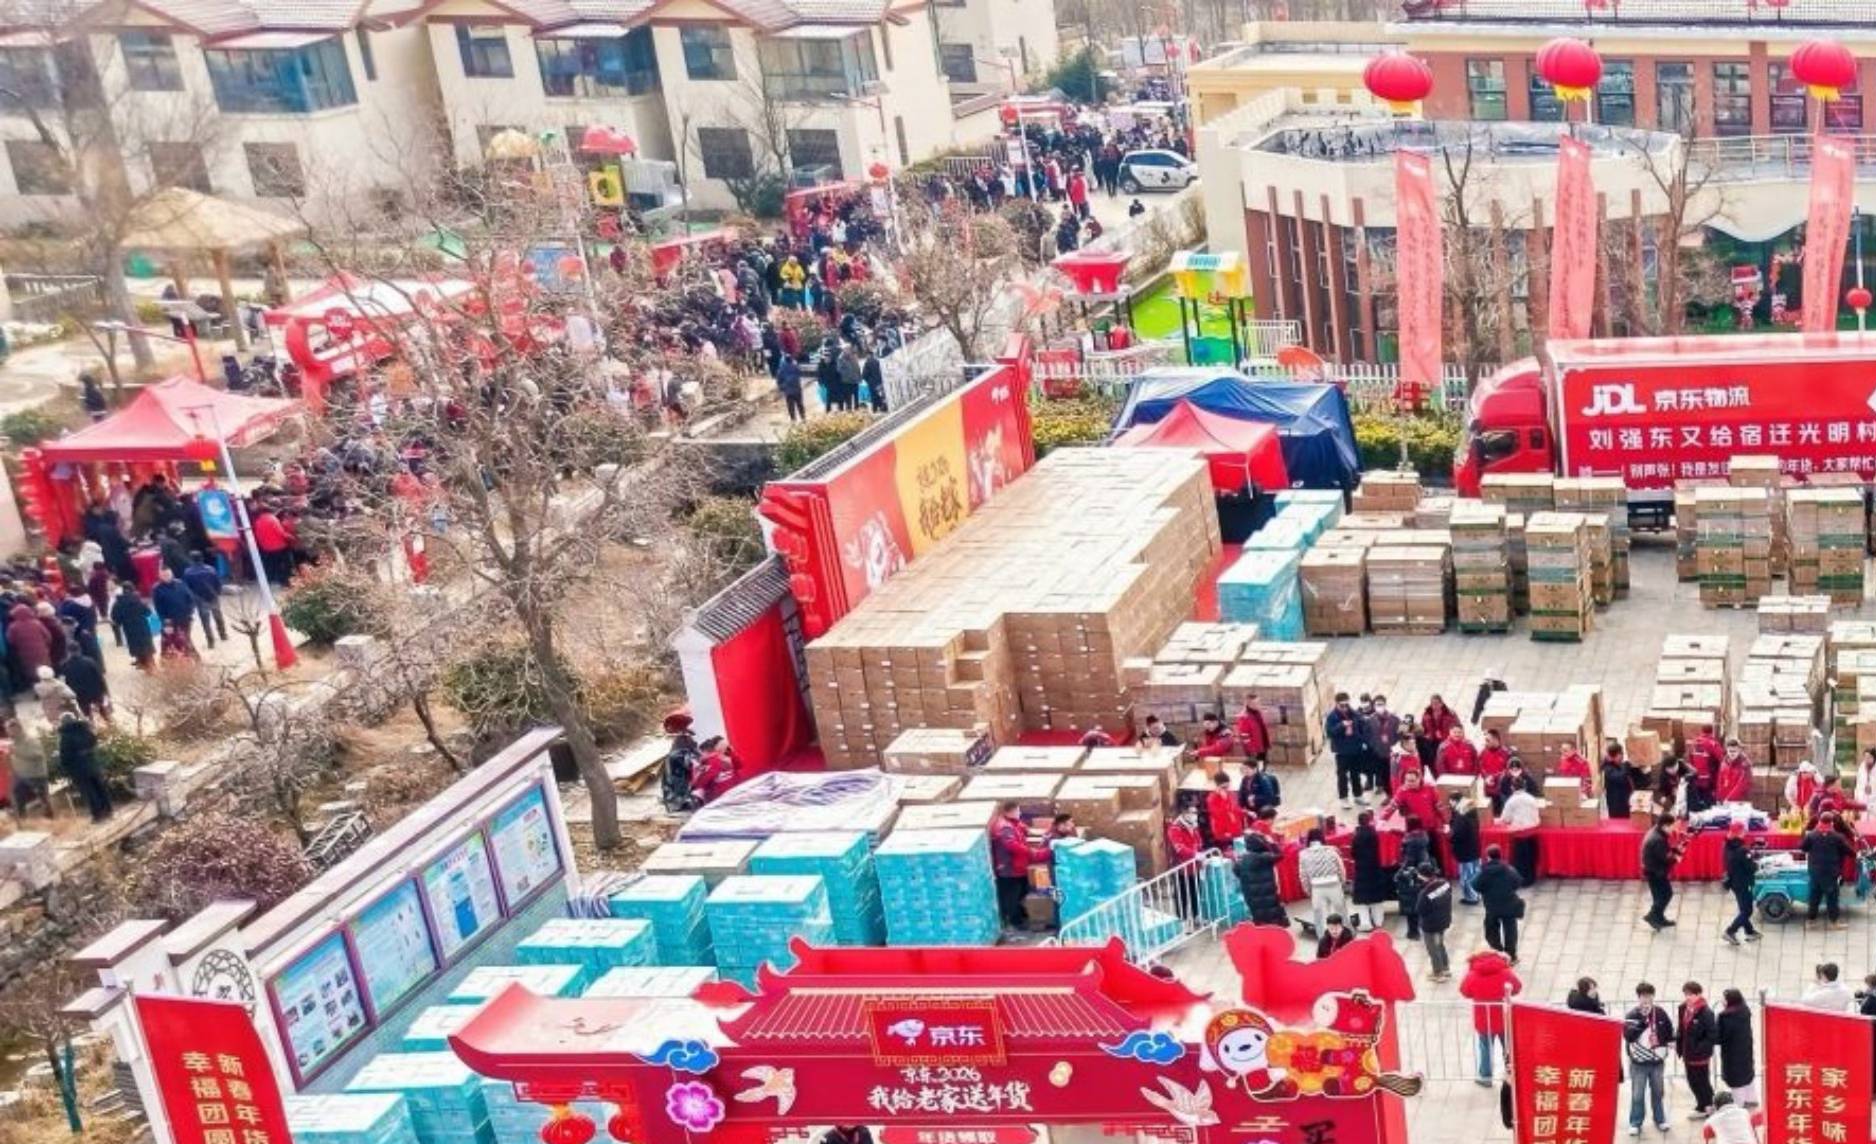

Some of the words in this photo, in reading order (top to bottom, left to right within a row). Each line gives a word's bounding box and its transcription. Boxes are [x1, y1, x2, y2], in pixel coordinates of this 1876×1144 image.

[1582, 383, 1647, 416] JDL
[1655, 386, 1751, 411] 京东物流
[929, 1025, 985, 1046] 京东
[868, 1081, 1034, 1115] 我给老家送年货
[1820, 1066, 1849, 1143] 家乡味
